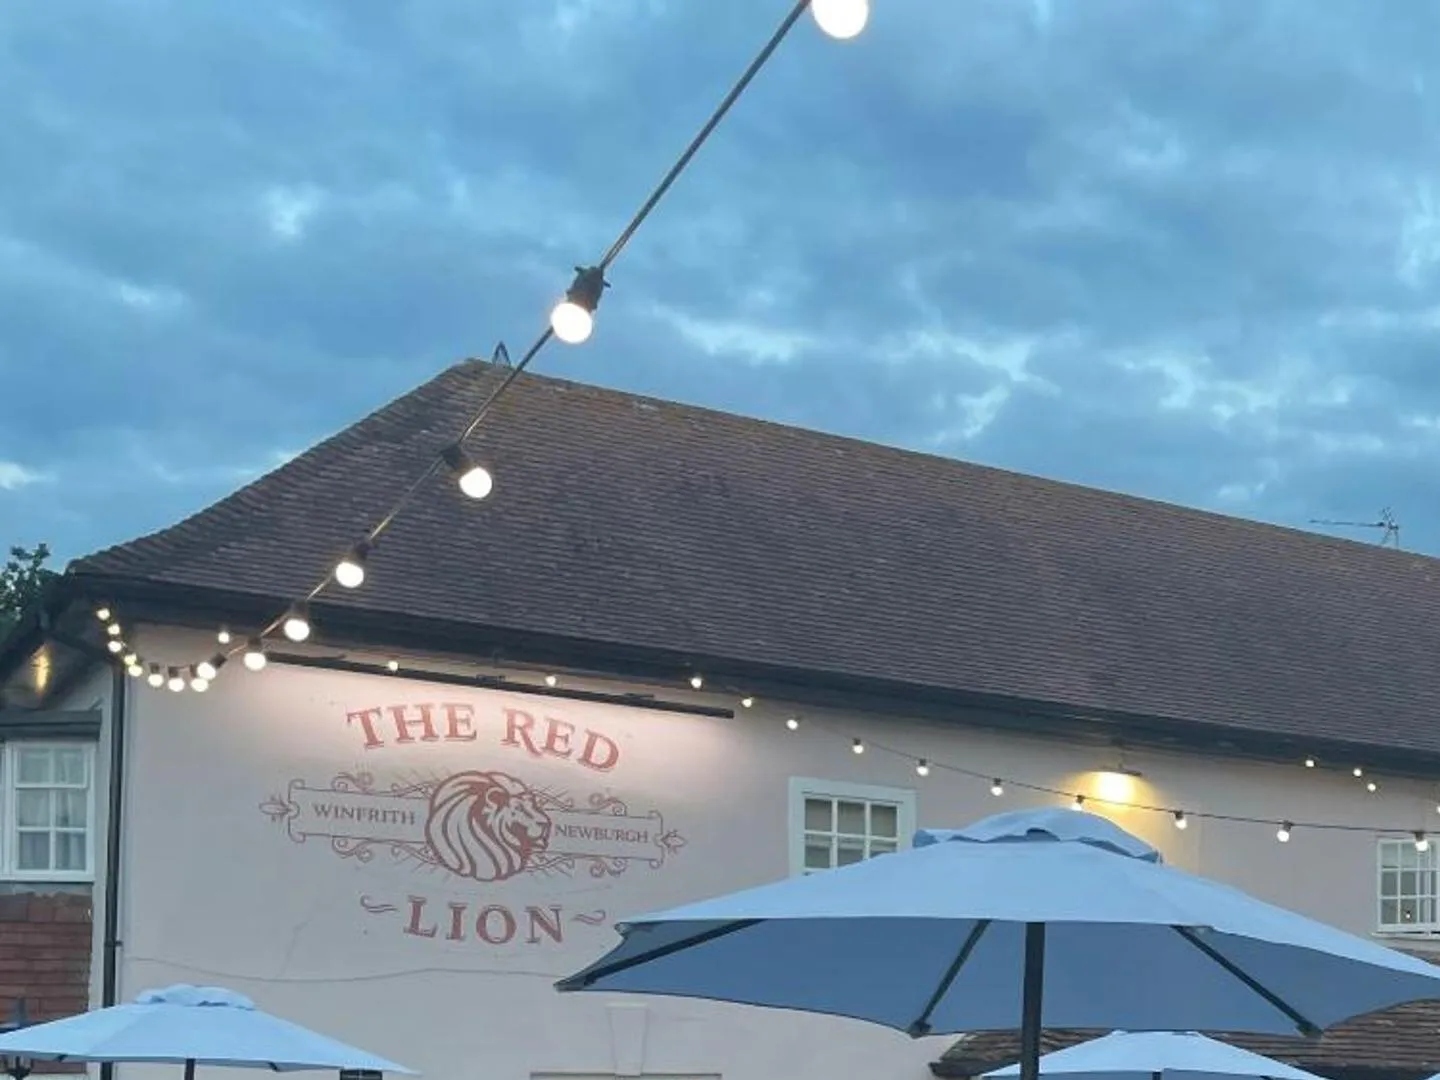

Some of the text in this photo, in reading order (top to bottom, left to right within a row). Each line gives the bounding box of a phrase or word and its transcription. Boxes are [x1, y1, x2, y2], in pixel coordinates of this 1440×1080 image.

[346, 702, 620, 773] THE RED
[312, 803, 416, 825] WINFRITH
[555, 824, 649, 843] NEWBURGH
[403, 895, 563, 944] LION
